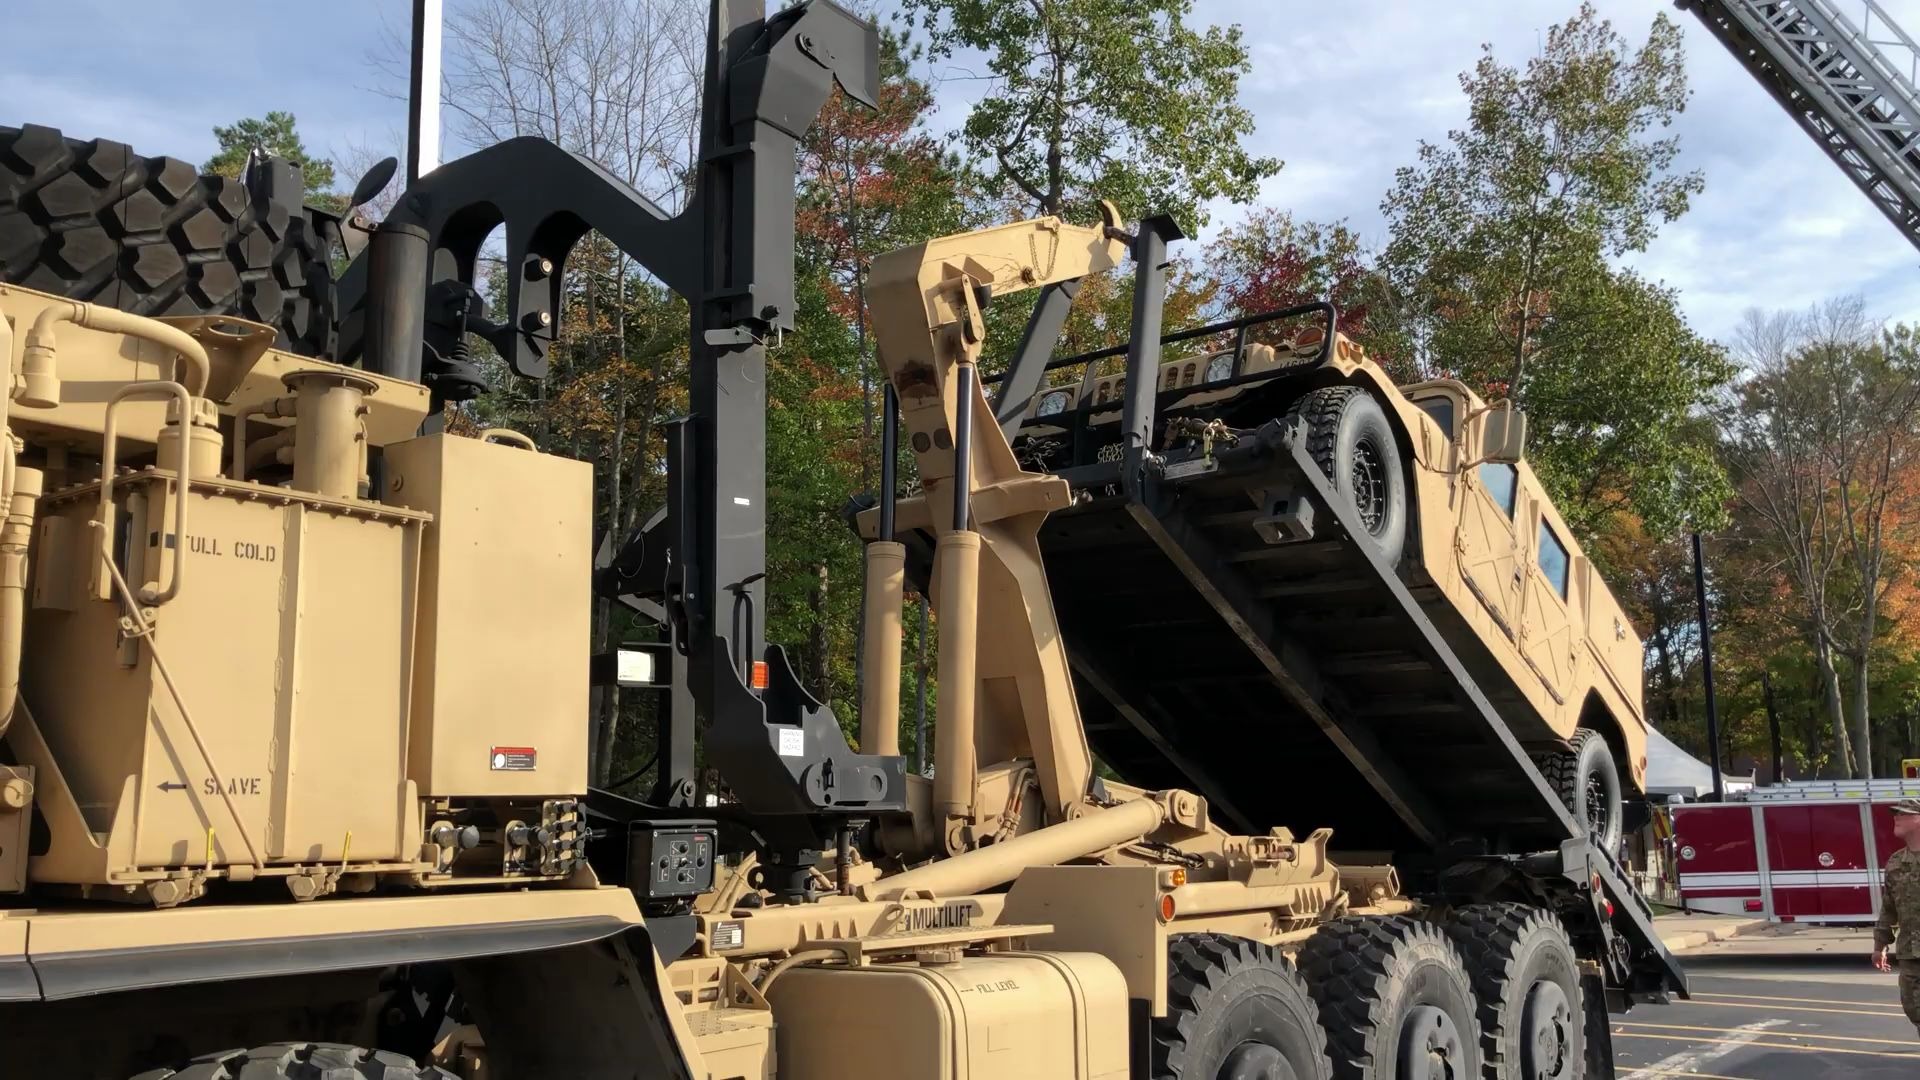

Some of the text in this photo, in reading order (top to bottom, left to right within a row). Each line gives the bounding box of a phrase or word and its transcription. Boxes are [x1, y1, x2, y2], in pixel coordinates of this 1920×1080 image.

[185, 535, 276, 562] ULL COLD
[912, 904, 972, 930] MULTILIFT
